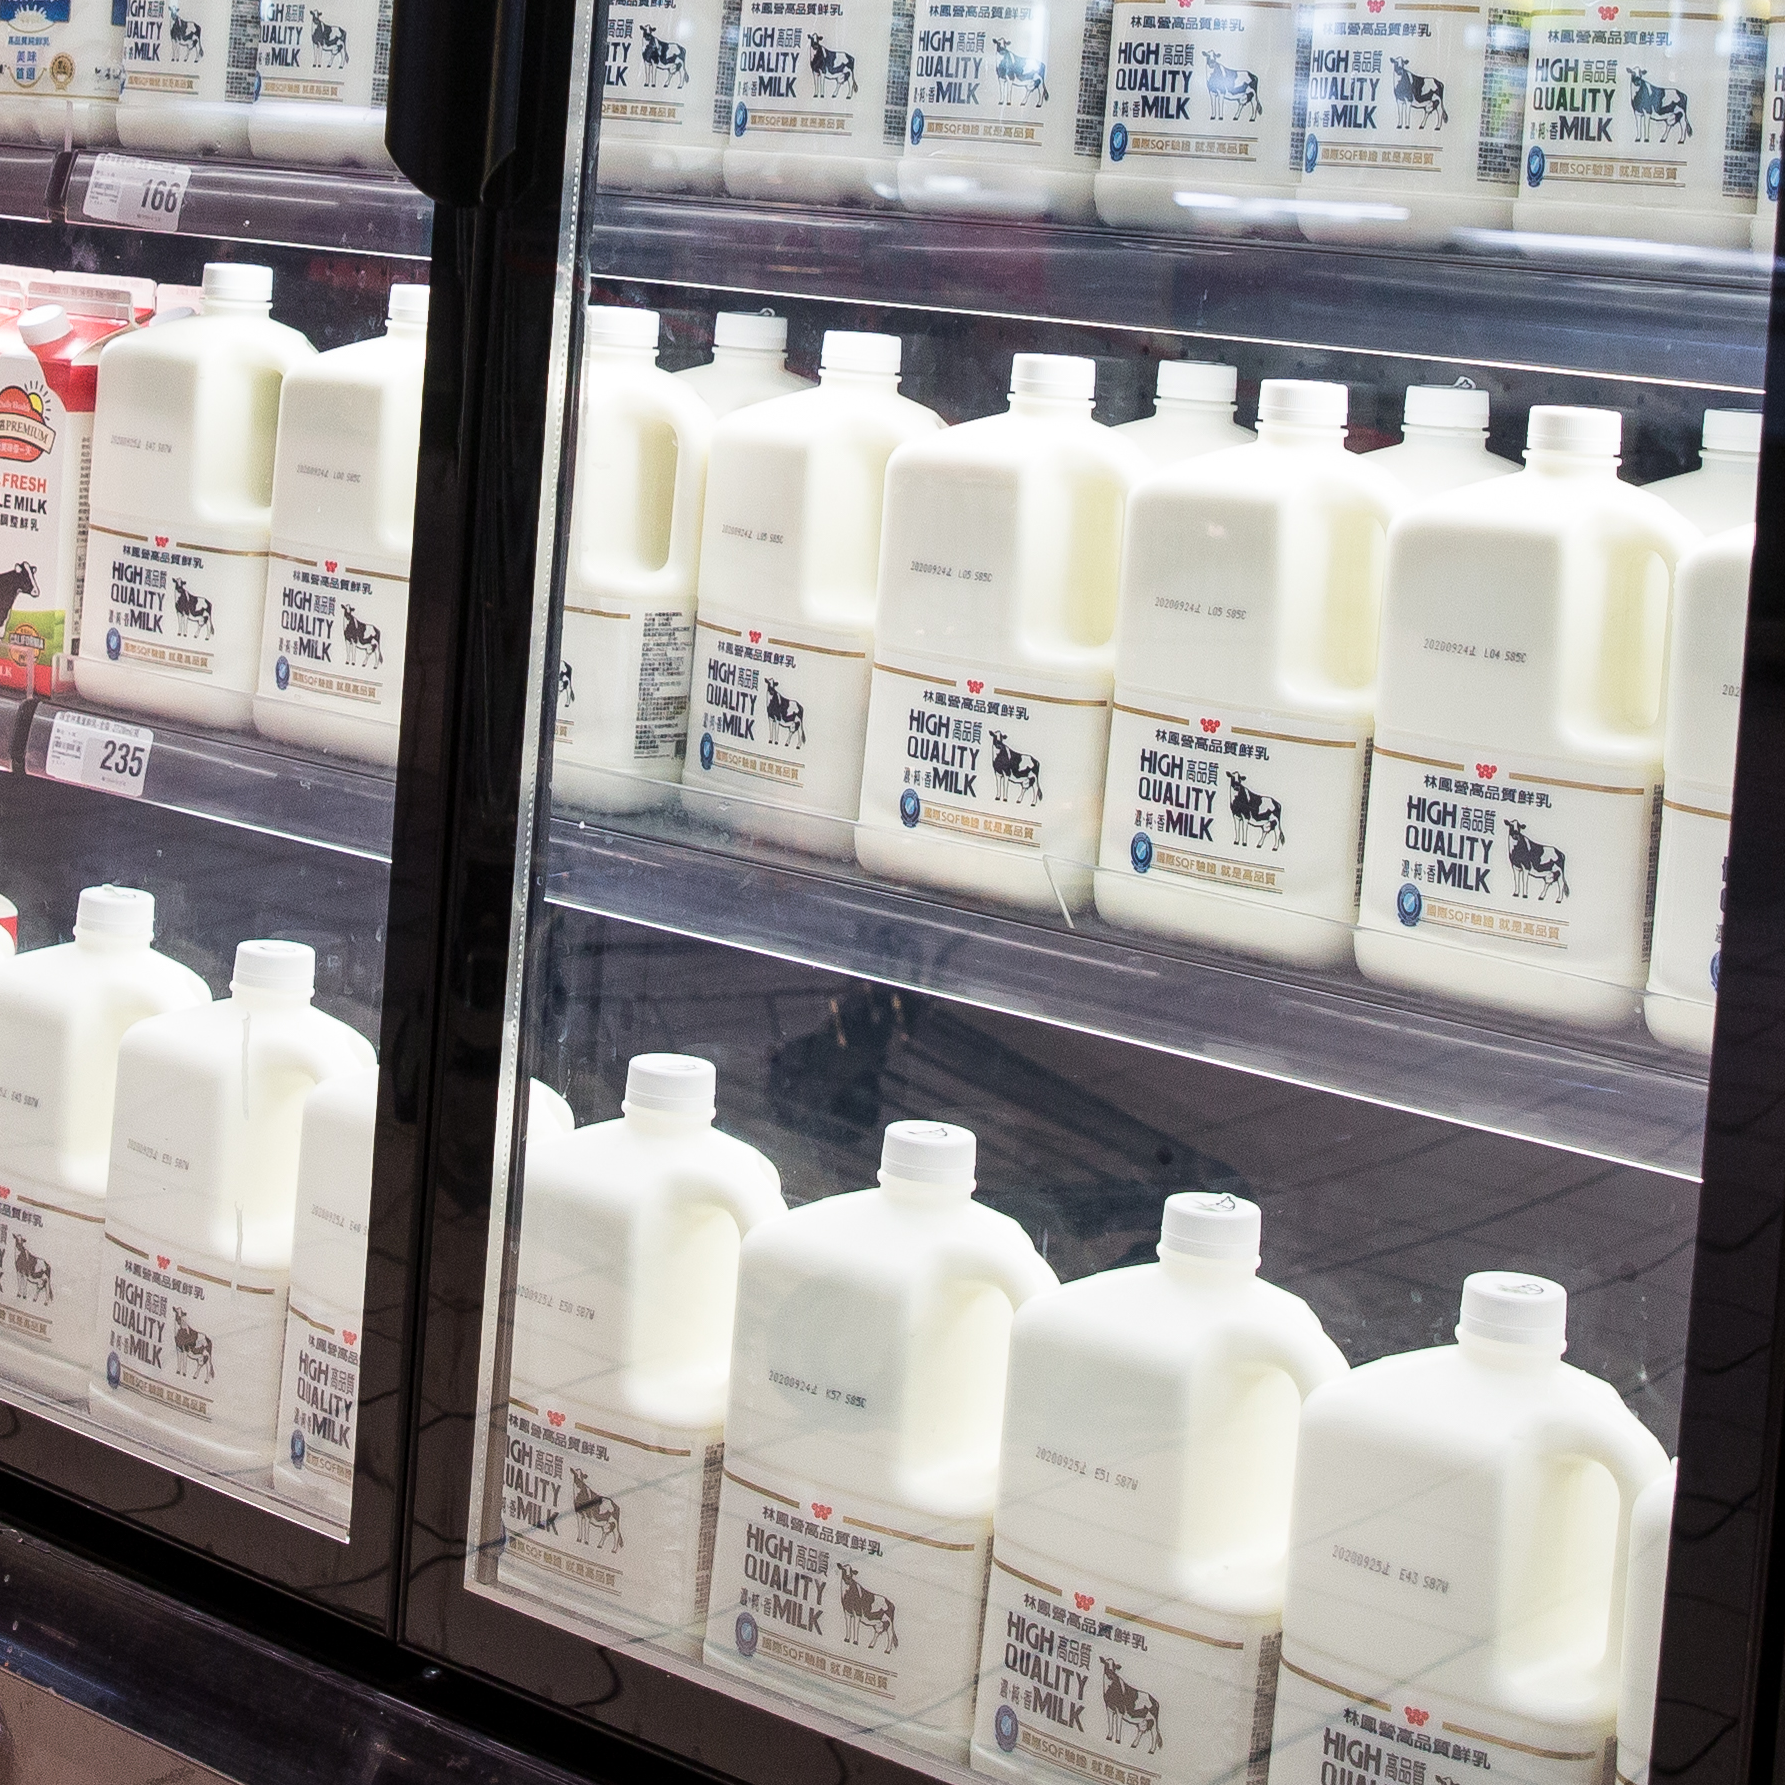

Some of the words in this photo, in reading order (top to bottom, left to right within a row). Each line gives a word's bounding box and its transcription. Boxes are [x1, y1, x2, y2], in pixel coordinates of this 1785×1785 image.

[1547, 29, 1672, 47] 林鳳營高品質鮮乳
[1535, 58, 1579, 83] HIGH
[1582, 60, 1617, 84] 高品質
[1532, 87, 1615, 112] QUALITY
[1559, 117, 1612, 142] MILK
[142, 179, 178, 214] 166
[2, 473, 47, 494] FRESH
[14, 494, 47, 515] MILK
[122, 544, 203, 569] 林鳳營高品質鮮乳
[112, 562, 142, 586] HIGH
[145, 568, 167, 590] 高品質
[110, 584, 165, 610] QUALITY
[129, 608, 163, 634] MILK
[10, 634, 45, 649] CALIFORNIA
[100, 740, 143, 778] 235
[1424, 775, 1551, 808] 林鳳營高品質鮮乳
[1407, 795, 1457, 829] HIGH
[1460, 807, 1495, 835] 高品質
[1405, 825, 1493, 864] QUALITY
[1437, 860, 1490, 893] MILK
